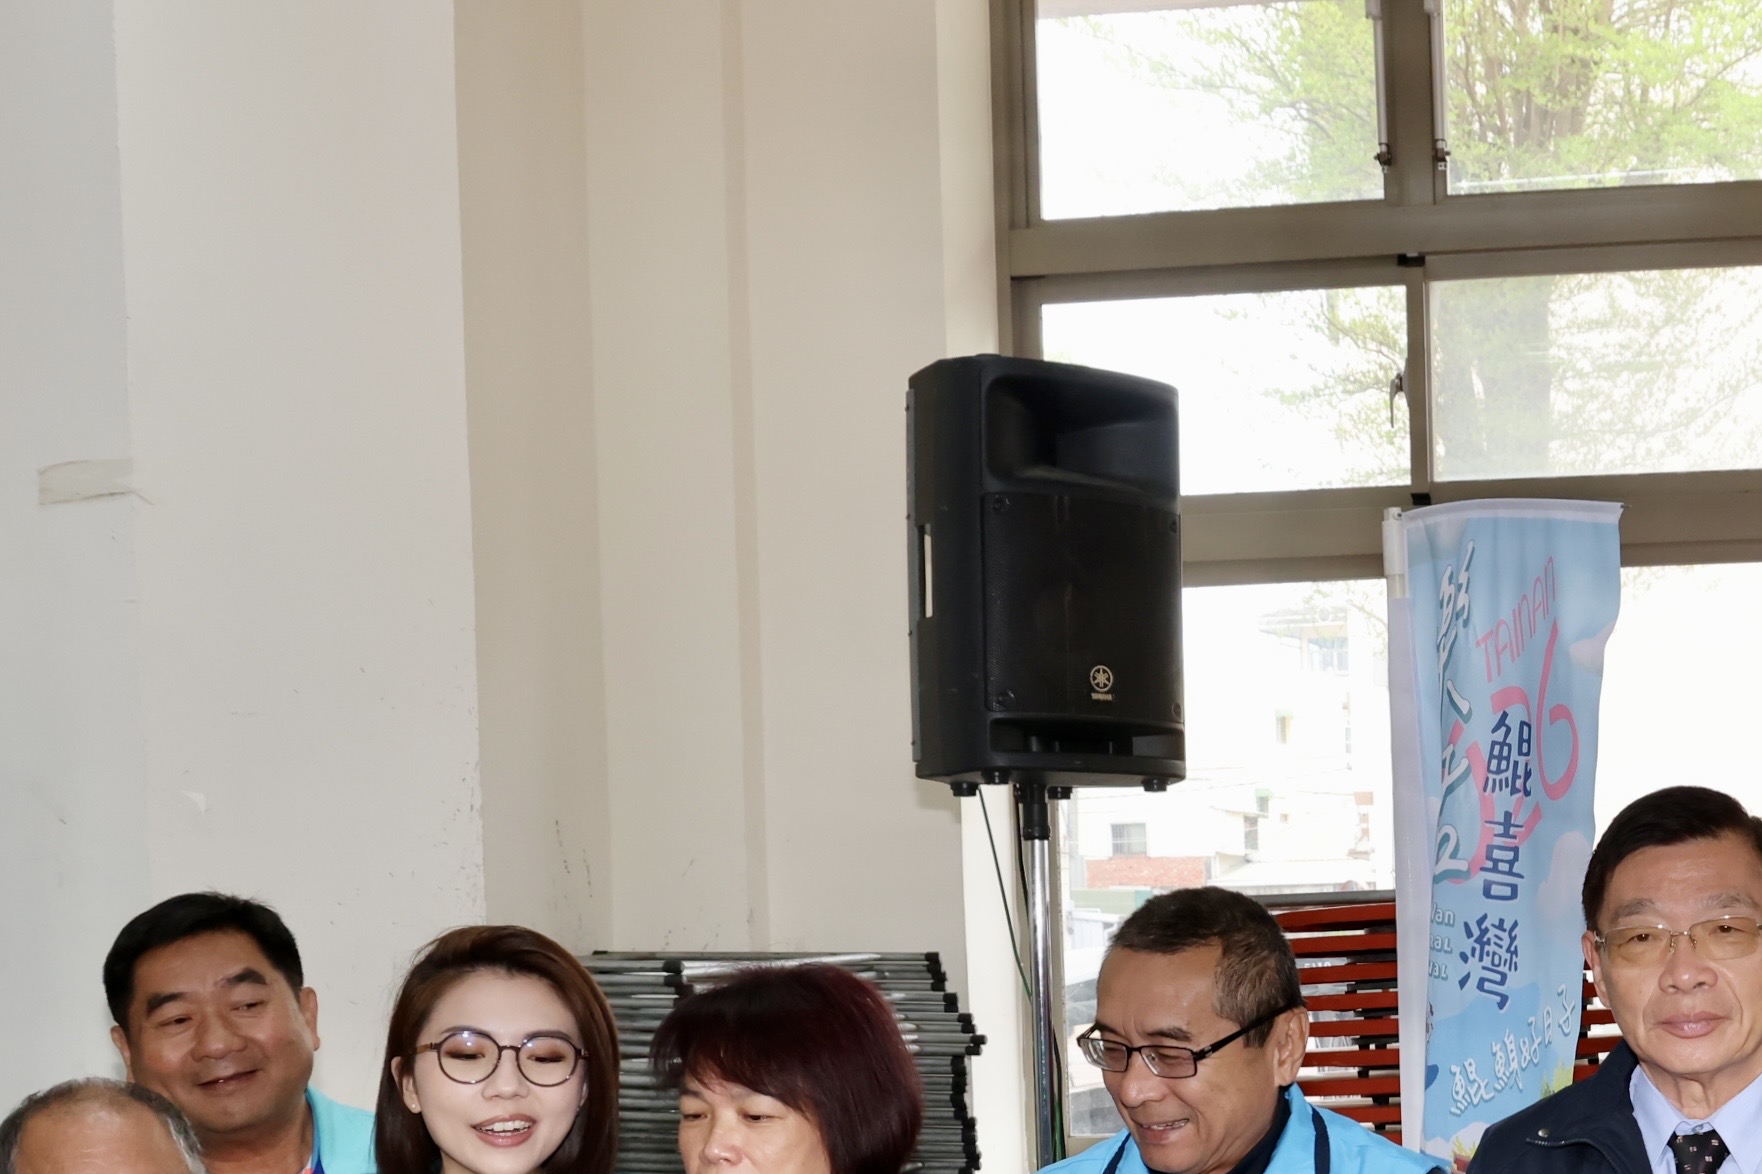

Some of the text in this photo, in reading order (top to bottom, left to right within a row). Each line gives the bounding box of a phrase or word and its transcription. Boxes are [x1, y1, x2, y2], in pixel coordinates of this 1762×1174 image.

[1475, 555, 1556, 683] TAINAN
[1458, 710, 1532, 1010] 鯤喜灣
